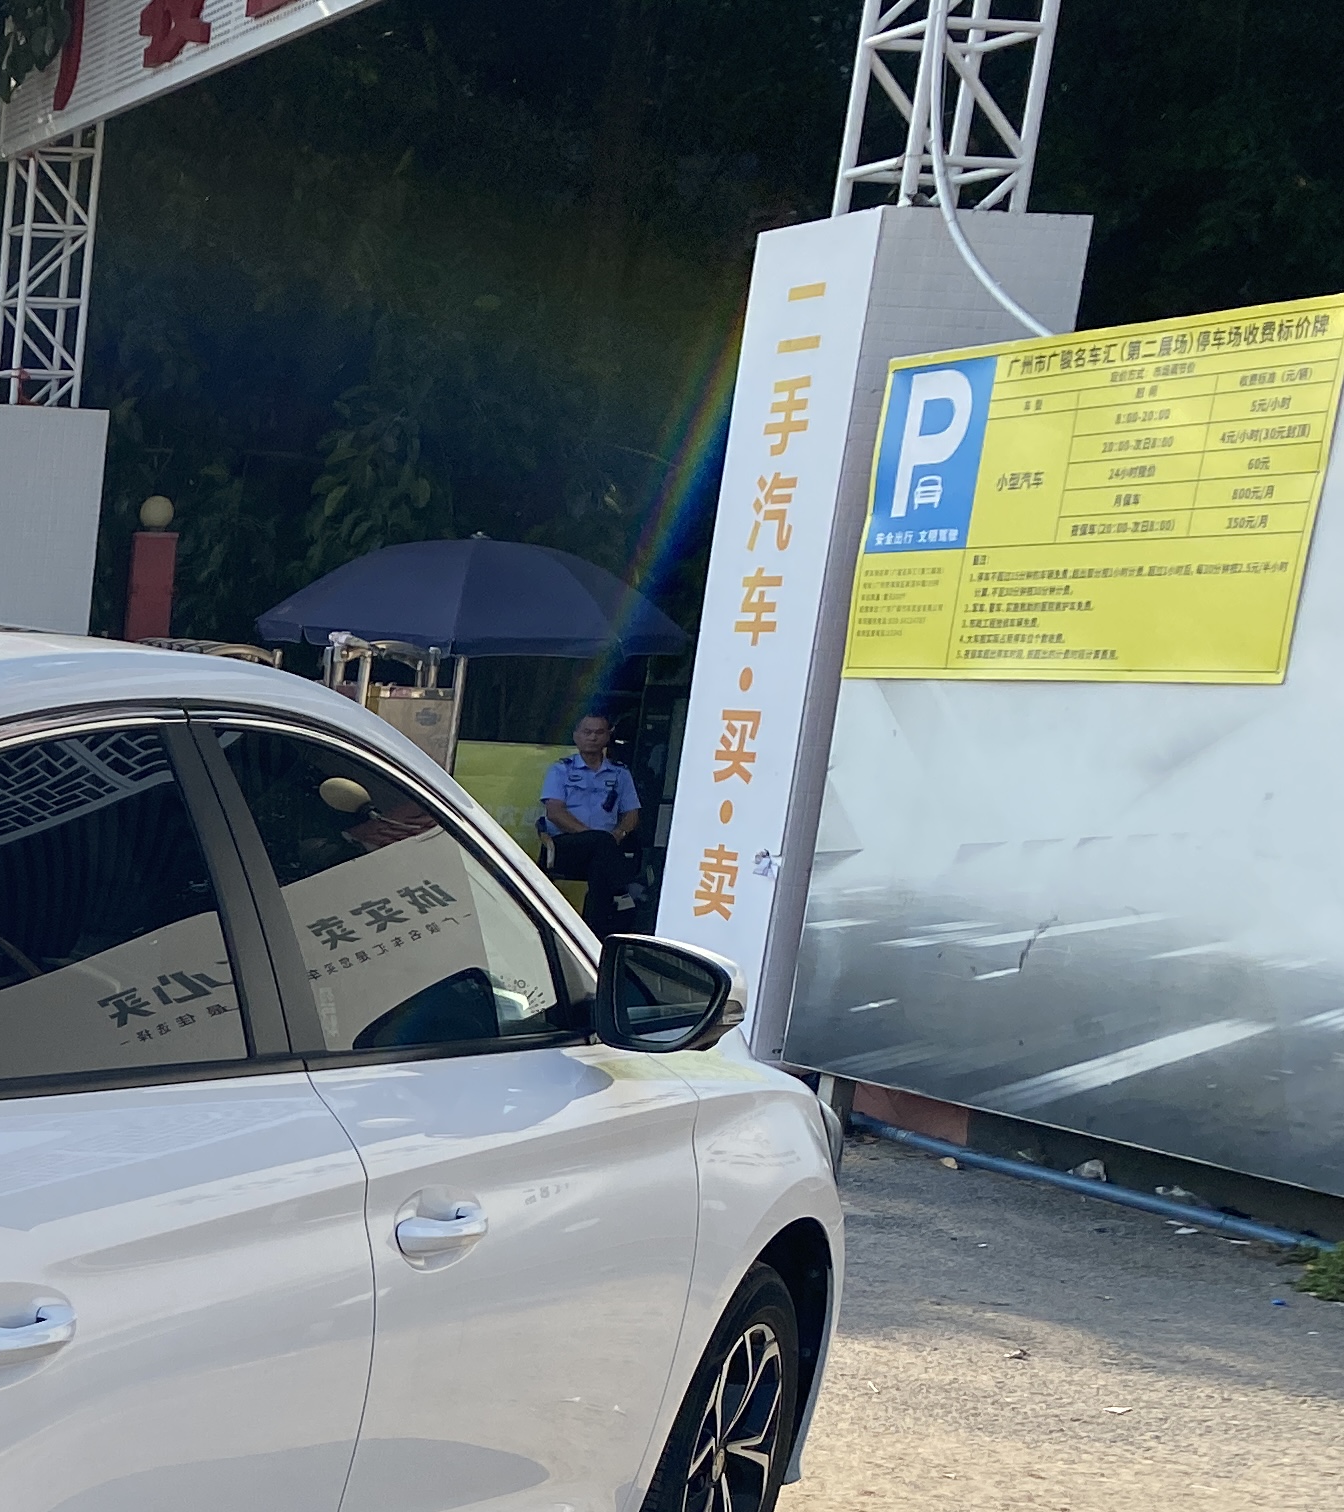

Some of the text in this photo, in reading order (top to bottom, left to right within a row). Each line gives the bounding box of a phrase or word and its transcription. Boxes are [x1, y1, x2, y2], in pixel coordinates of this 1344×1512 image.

[890, 369, 973, 518] P
[996, 471, 1045, 492] 小型汽车
